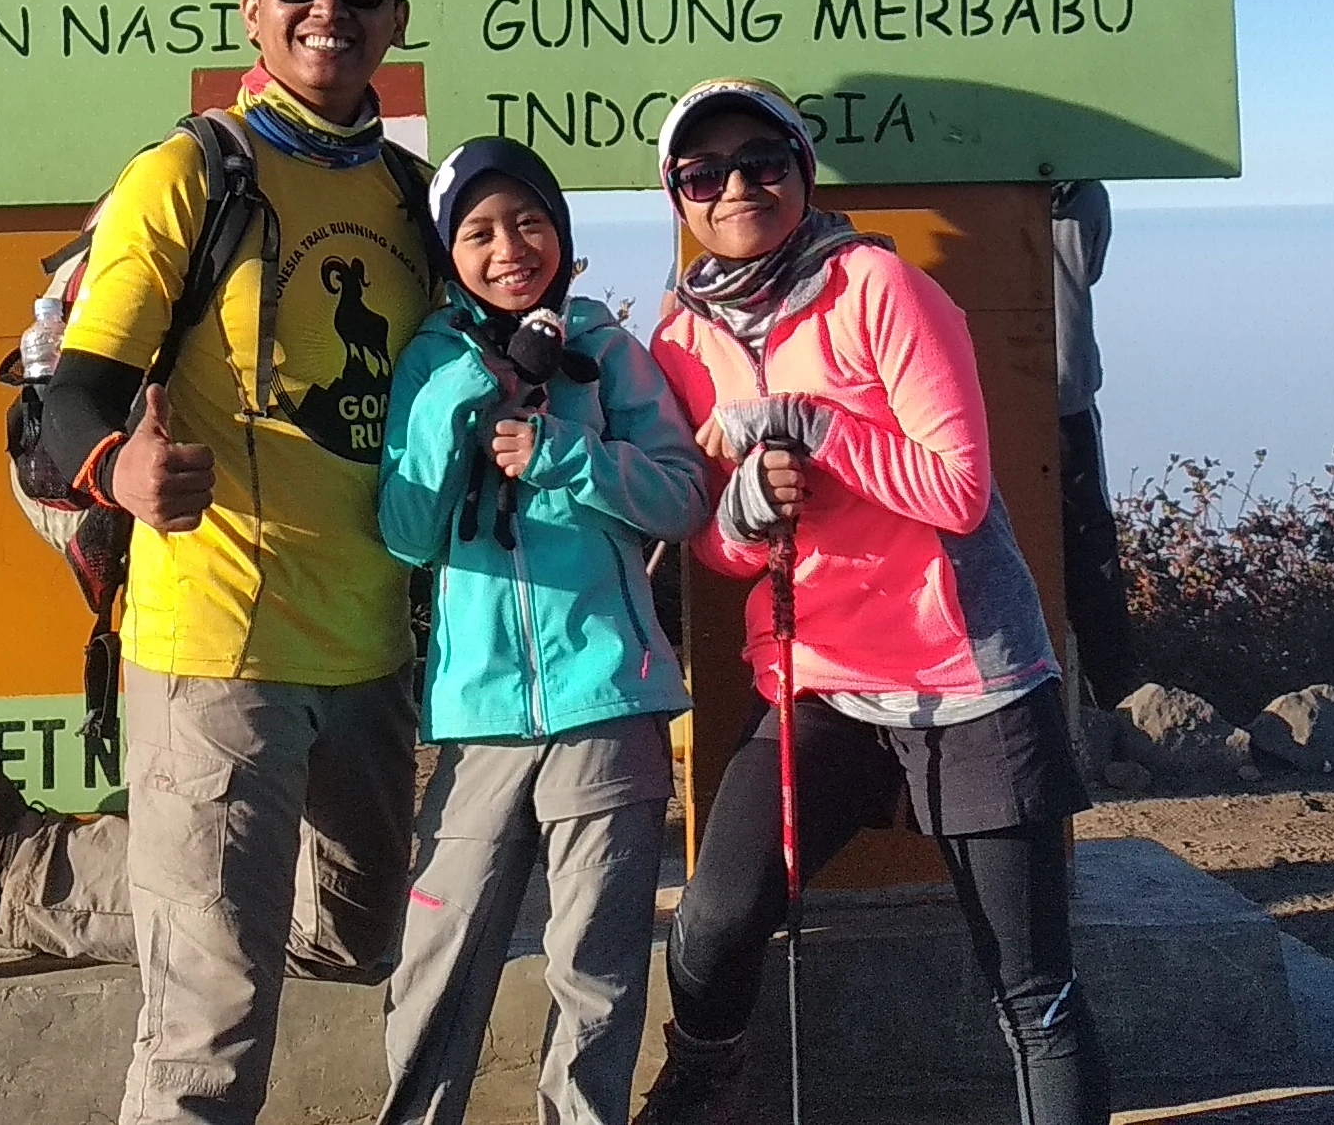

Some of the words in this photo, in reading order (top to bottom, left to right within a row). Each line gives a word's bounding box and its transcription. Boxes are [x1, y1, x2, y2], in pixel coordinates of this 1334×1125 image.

[487, 91, 914, 147] INDOSIA
[300, 226, 330, 251] TRAIL
[329, 221, 388, 249] RUNNING
[350, 422, 382, 449] RU
